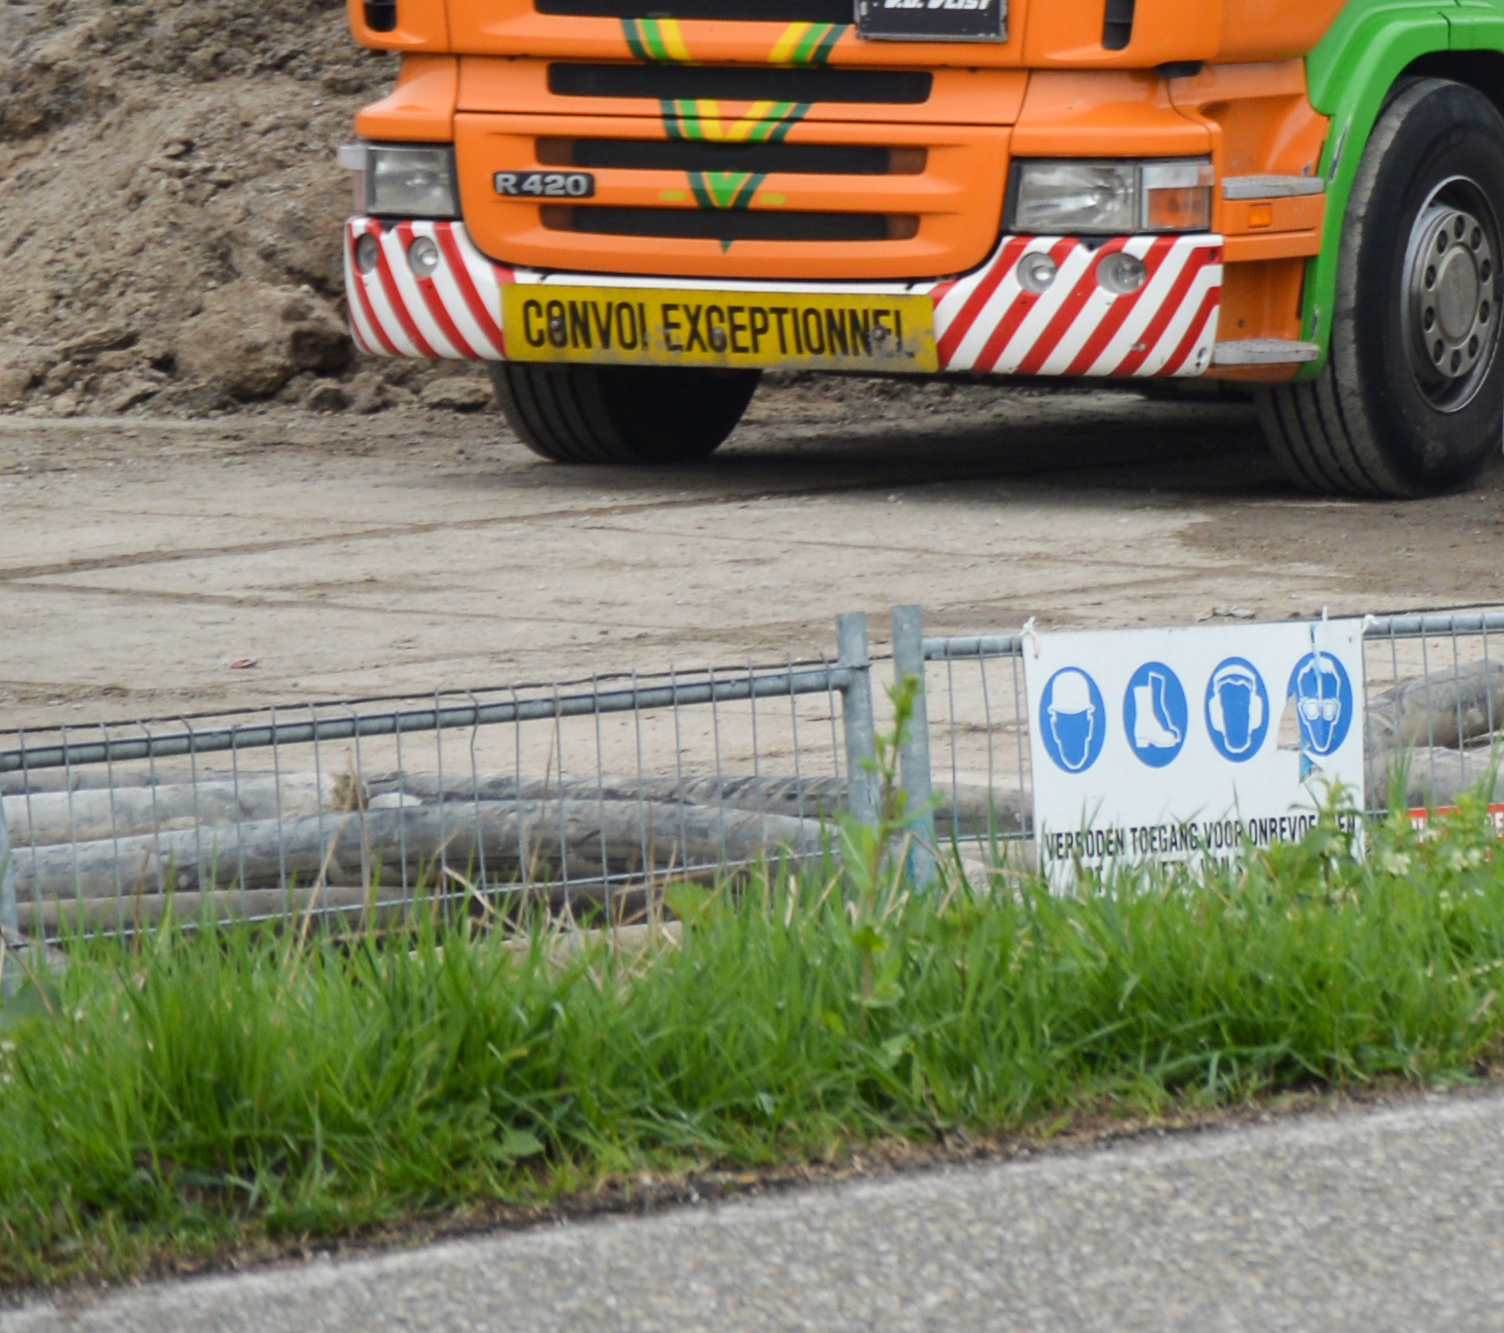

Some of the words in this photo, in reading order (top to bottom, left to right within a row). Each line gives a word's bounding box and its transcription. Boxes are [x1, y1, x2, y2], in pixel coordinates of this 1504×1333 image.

[496, 174, 519, 194] R
[521, 173, 589, 196] 420
[522, 298, 648, 351] CONVOI
[661, 302, 916, 358] EXCEPTIONNEL
[1130, 822, 1199, 855] TOEGANG
[1203, 819, 1242, 849] VOOR
